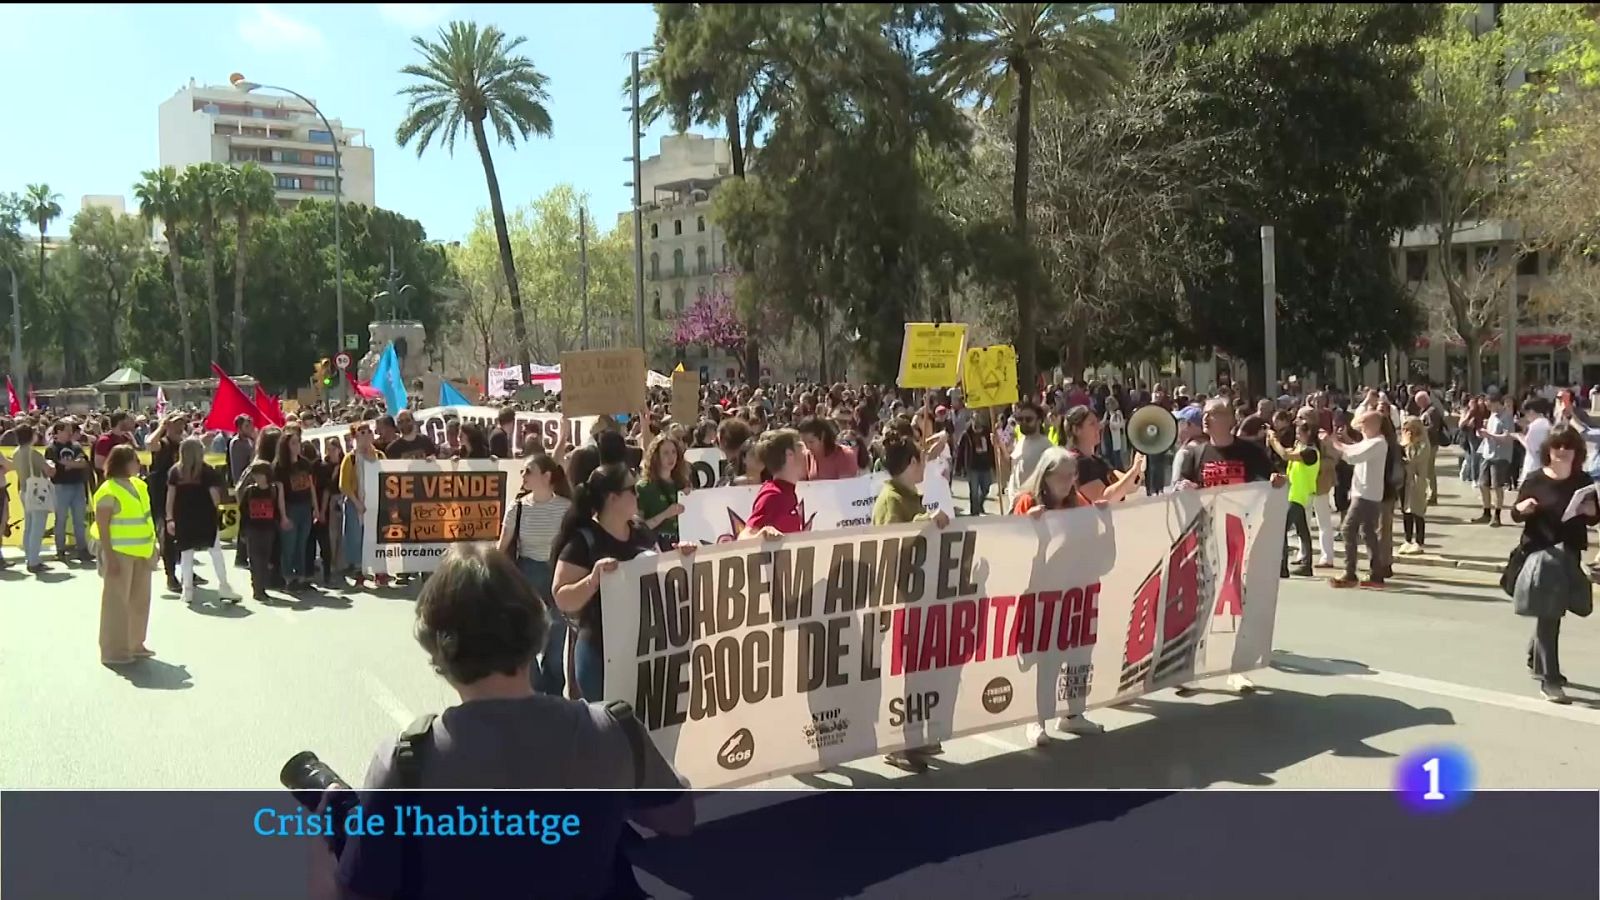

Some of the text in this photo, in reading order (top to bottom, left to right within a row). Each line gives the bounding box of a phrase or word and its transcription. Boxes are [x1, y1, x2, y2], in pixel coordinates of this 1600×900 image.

[385, 475, 499, 499] SE VENDE
[414, 521, 490, 539] puc pagar
[636, 531, 978, 657] ACABEM AMB EL
[634, 582, 1101, 731] NEGOCI DE L'HABITATGE
[812, 707, 842, 723] STOP
[889, 691, 940, 727] SHP
[727, 749, 751, 763] GOB
